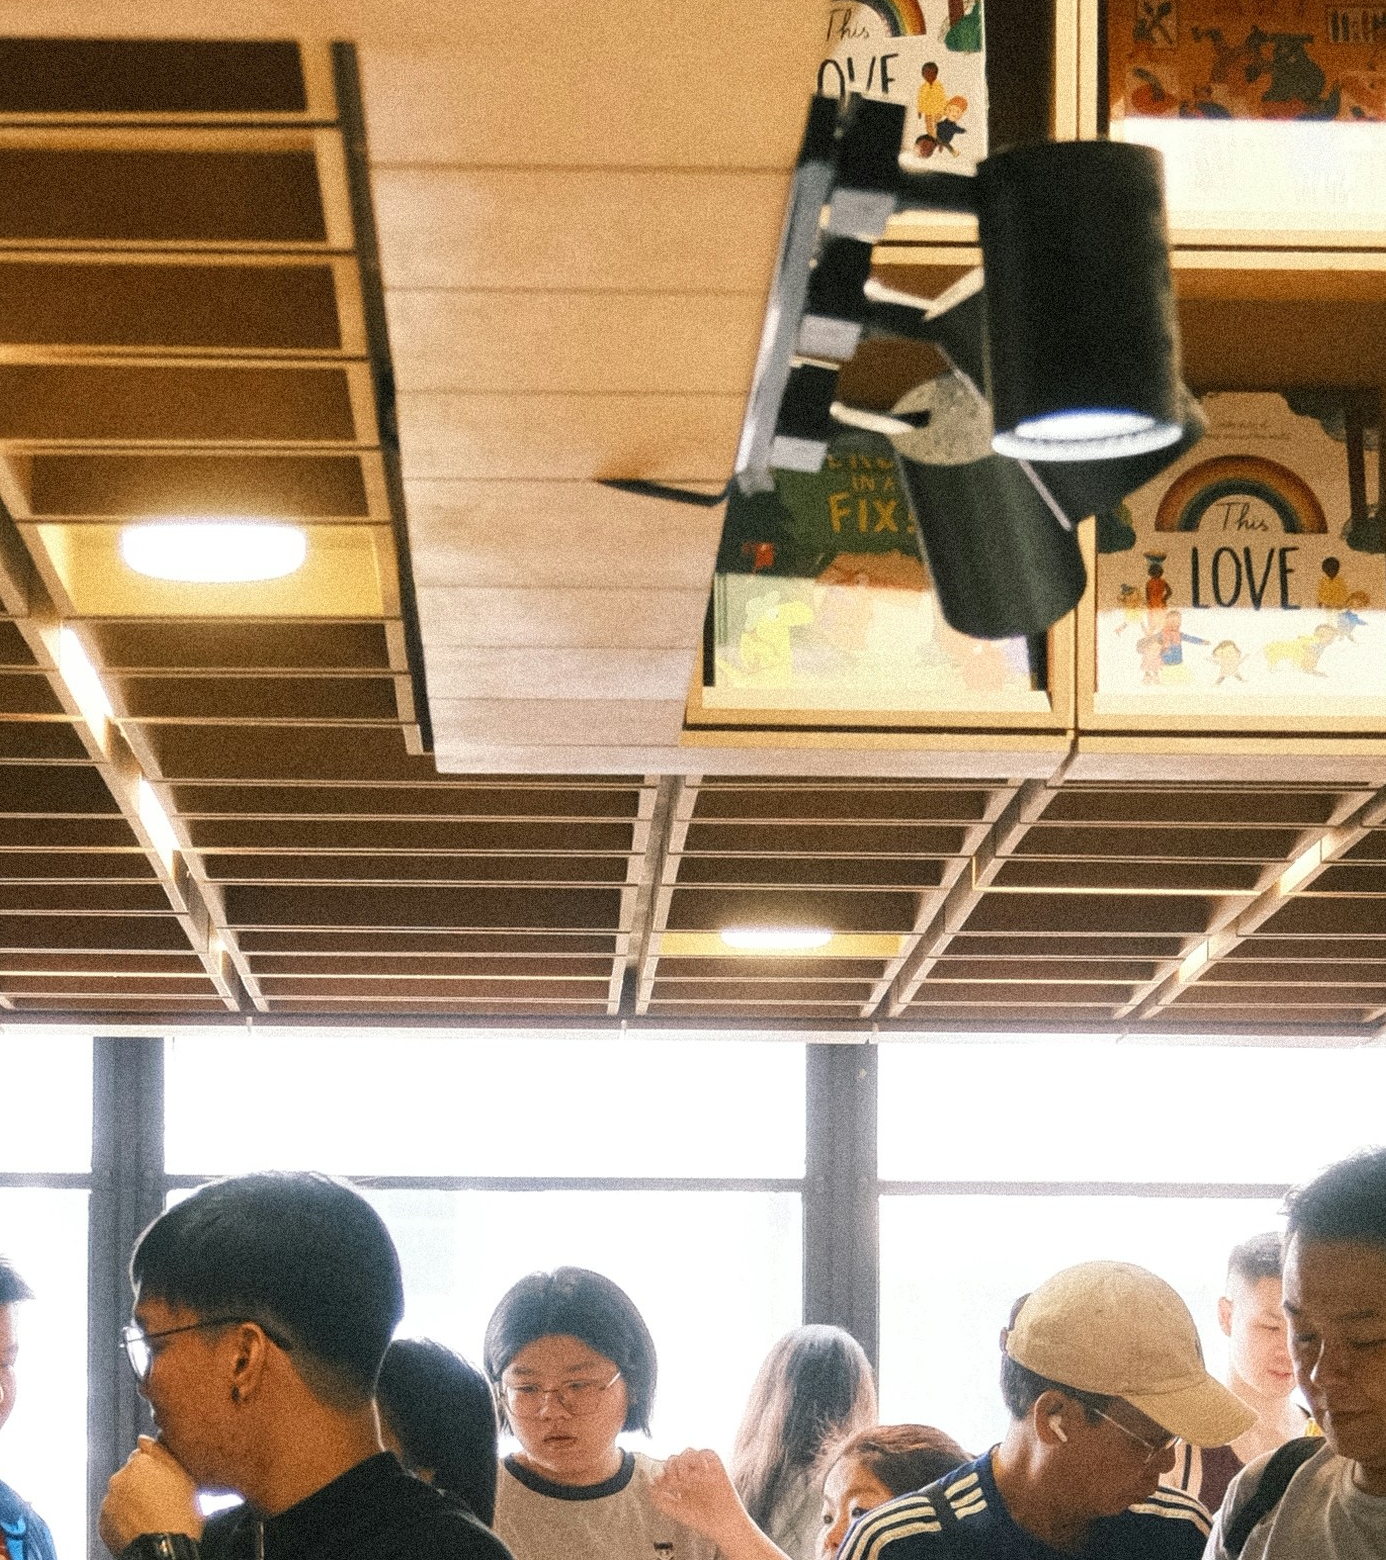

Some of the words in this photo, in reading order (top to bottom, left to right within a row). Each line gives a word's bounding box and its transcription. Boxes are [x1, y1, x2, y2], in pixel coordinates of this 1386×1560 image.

[816, 50, 900, 101] OVE
[1219, 501, 1269, 532] This
[1191, 545, 1301, 610] LOVE
